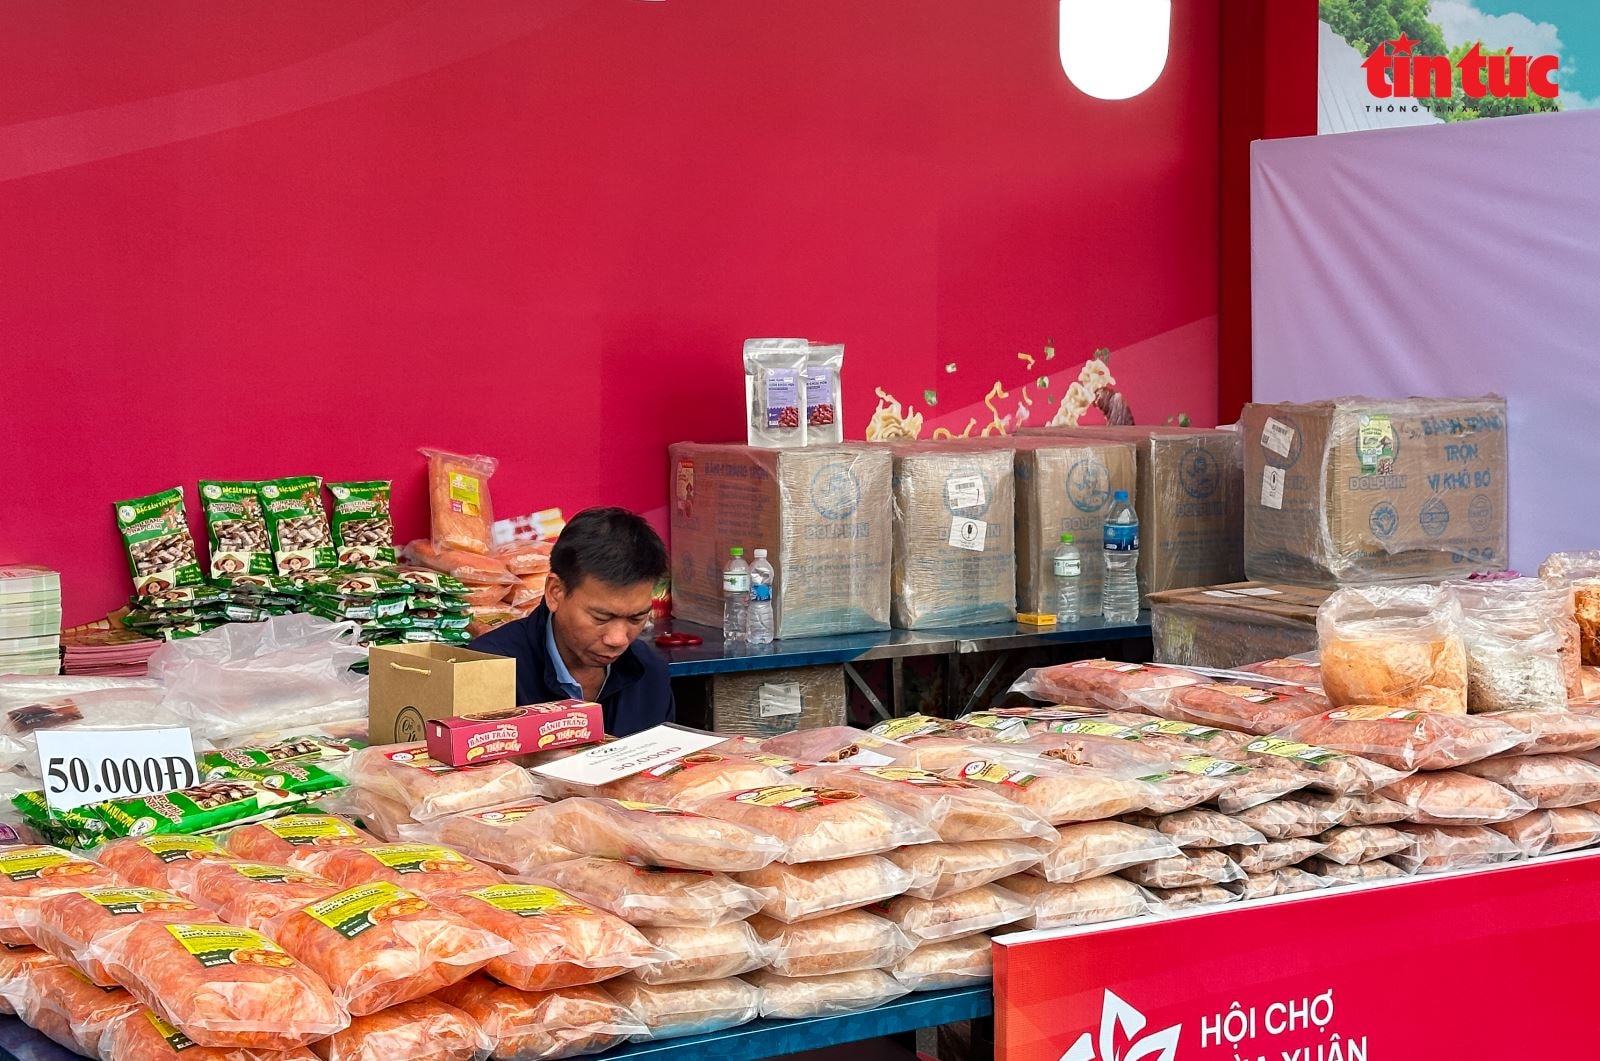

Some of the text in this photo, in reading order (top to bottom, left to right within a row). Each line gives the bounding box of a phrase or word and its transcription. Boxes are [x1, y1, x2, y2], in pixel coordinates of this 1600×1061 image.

[1349, 475, 1408, 490] DOLPHIN
[47, 756, 194, 793] 50.000Đ
[1201, 988, 1334, 1050] HỘI CHỢ
